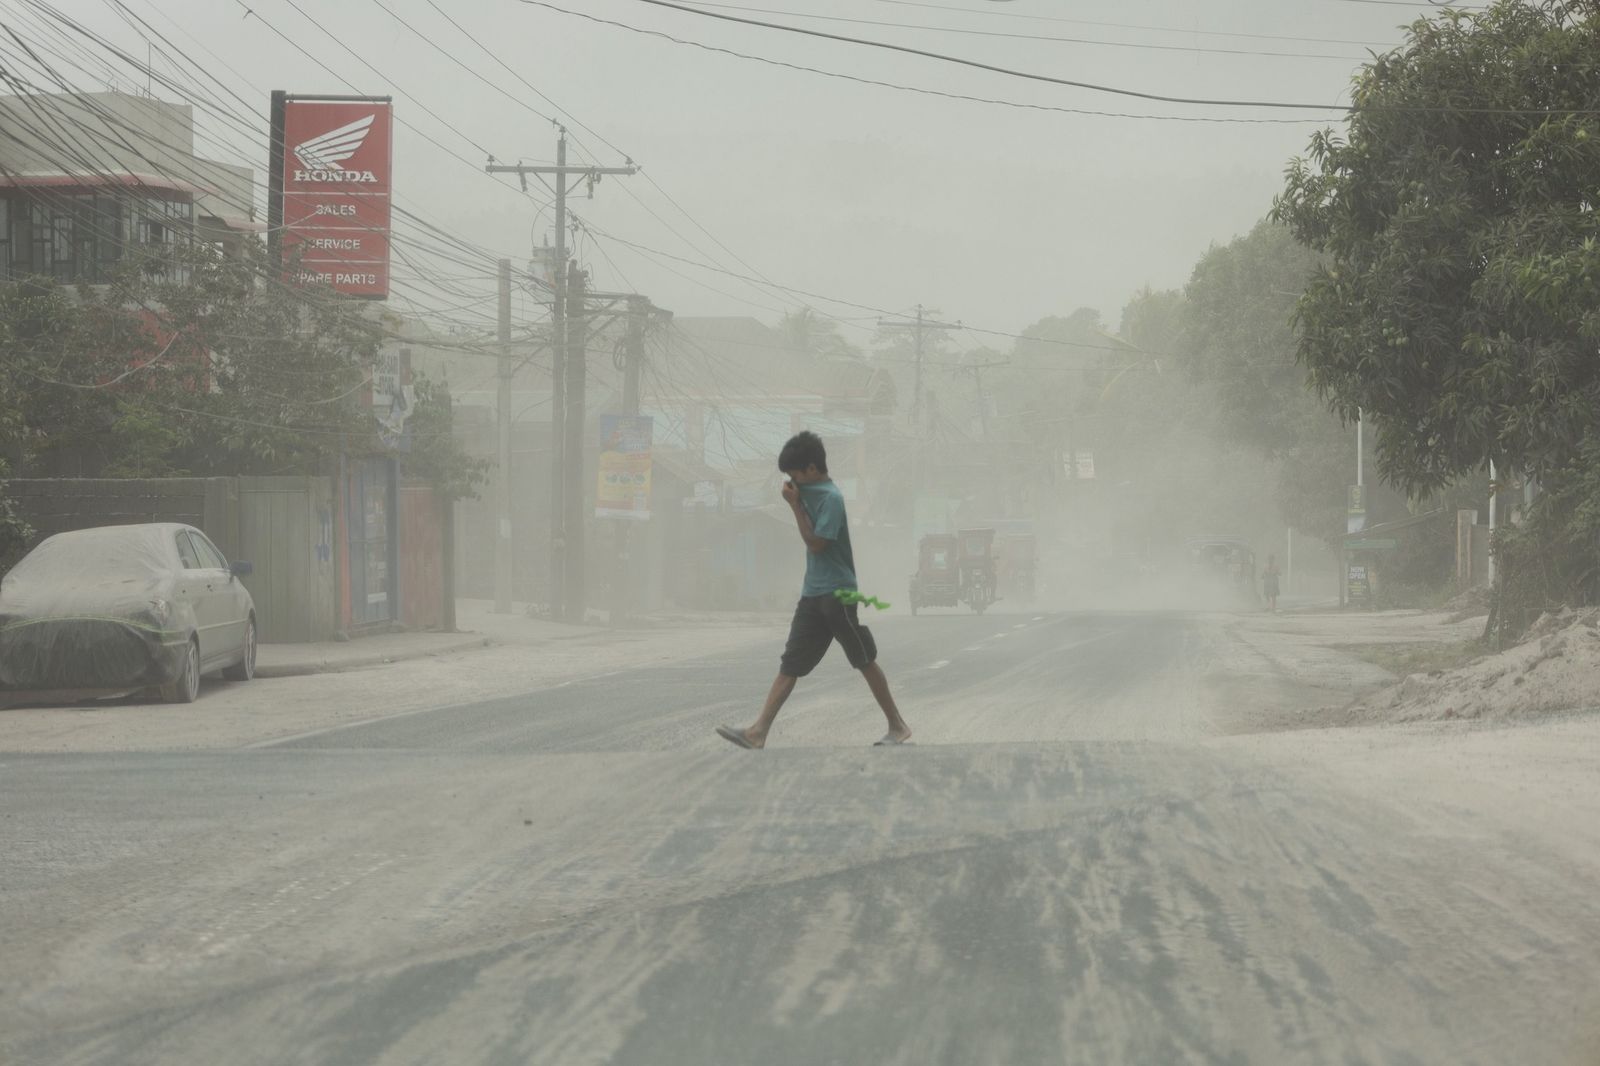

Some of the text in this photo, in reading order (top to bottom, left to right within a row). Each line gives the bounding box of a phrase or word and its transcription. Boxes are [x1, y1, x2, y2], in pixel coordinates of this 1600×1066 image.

[294, 170, 377, 182] HONDA
[316, 204, 356, 215] SALES
[293, 273, 376, 284] PARE PARTS
